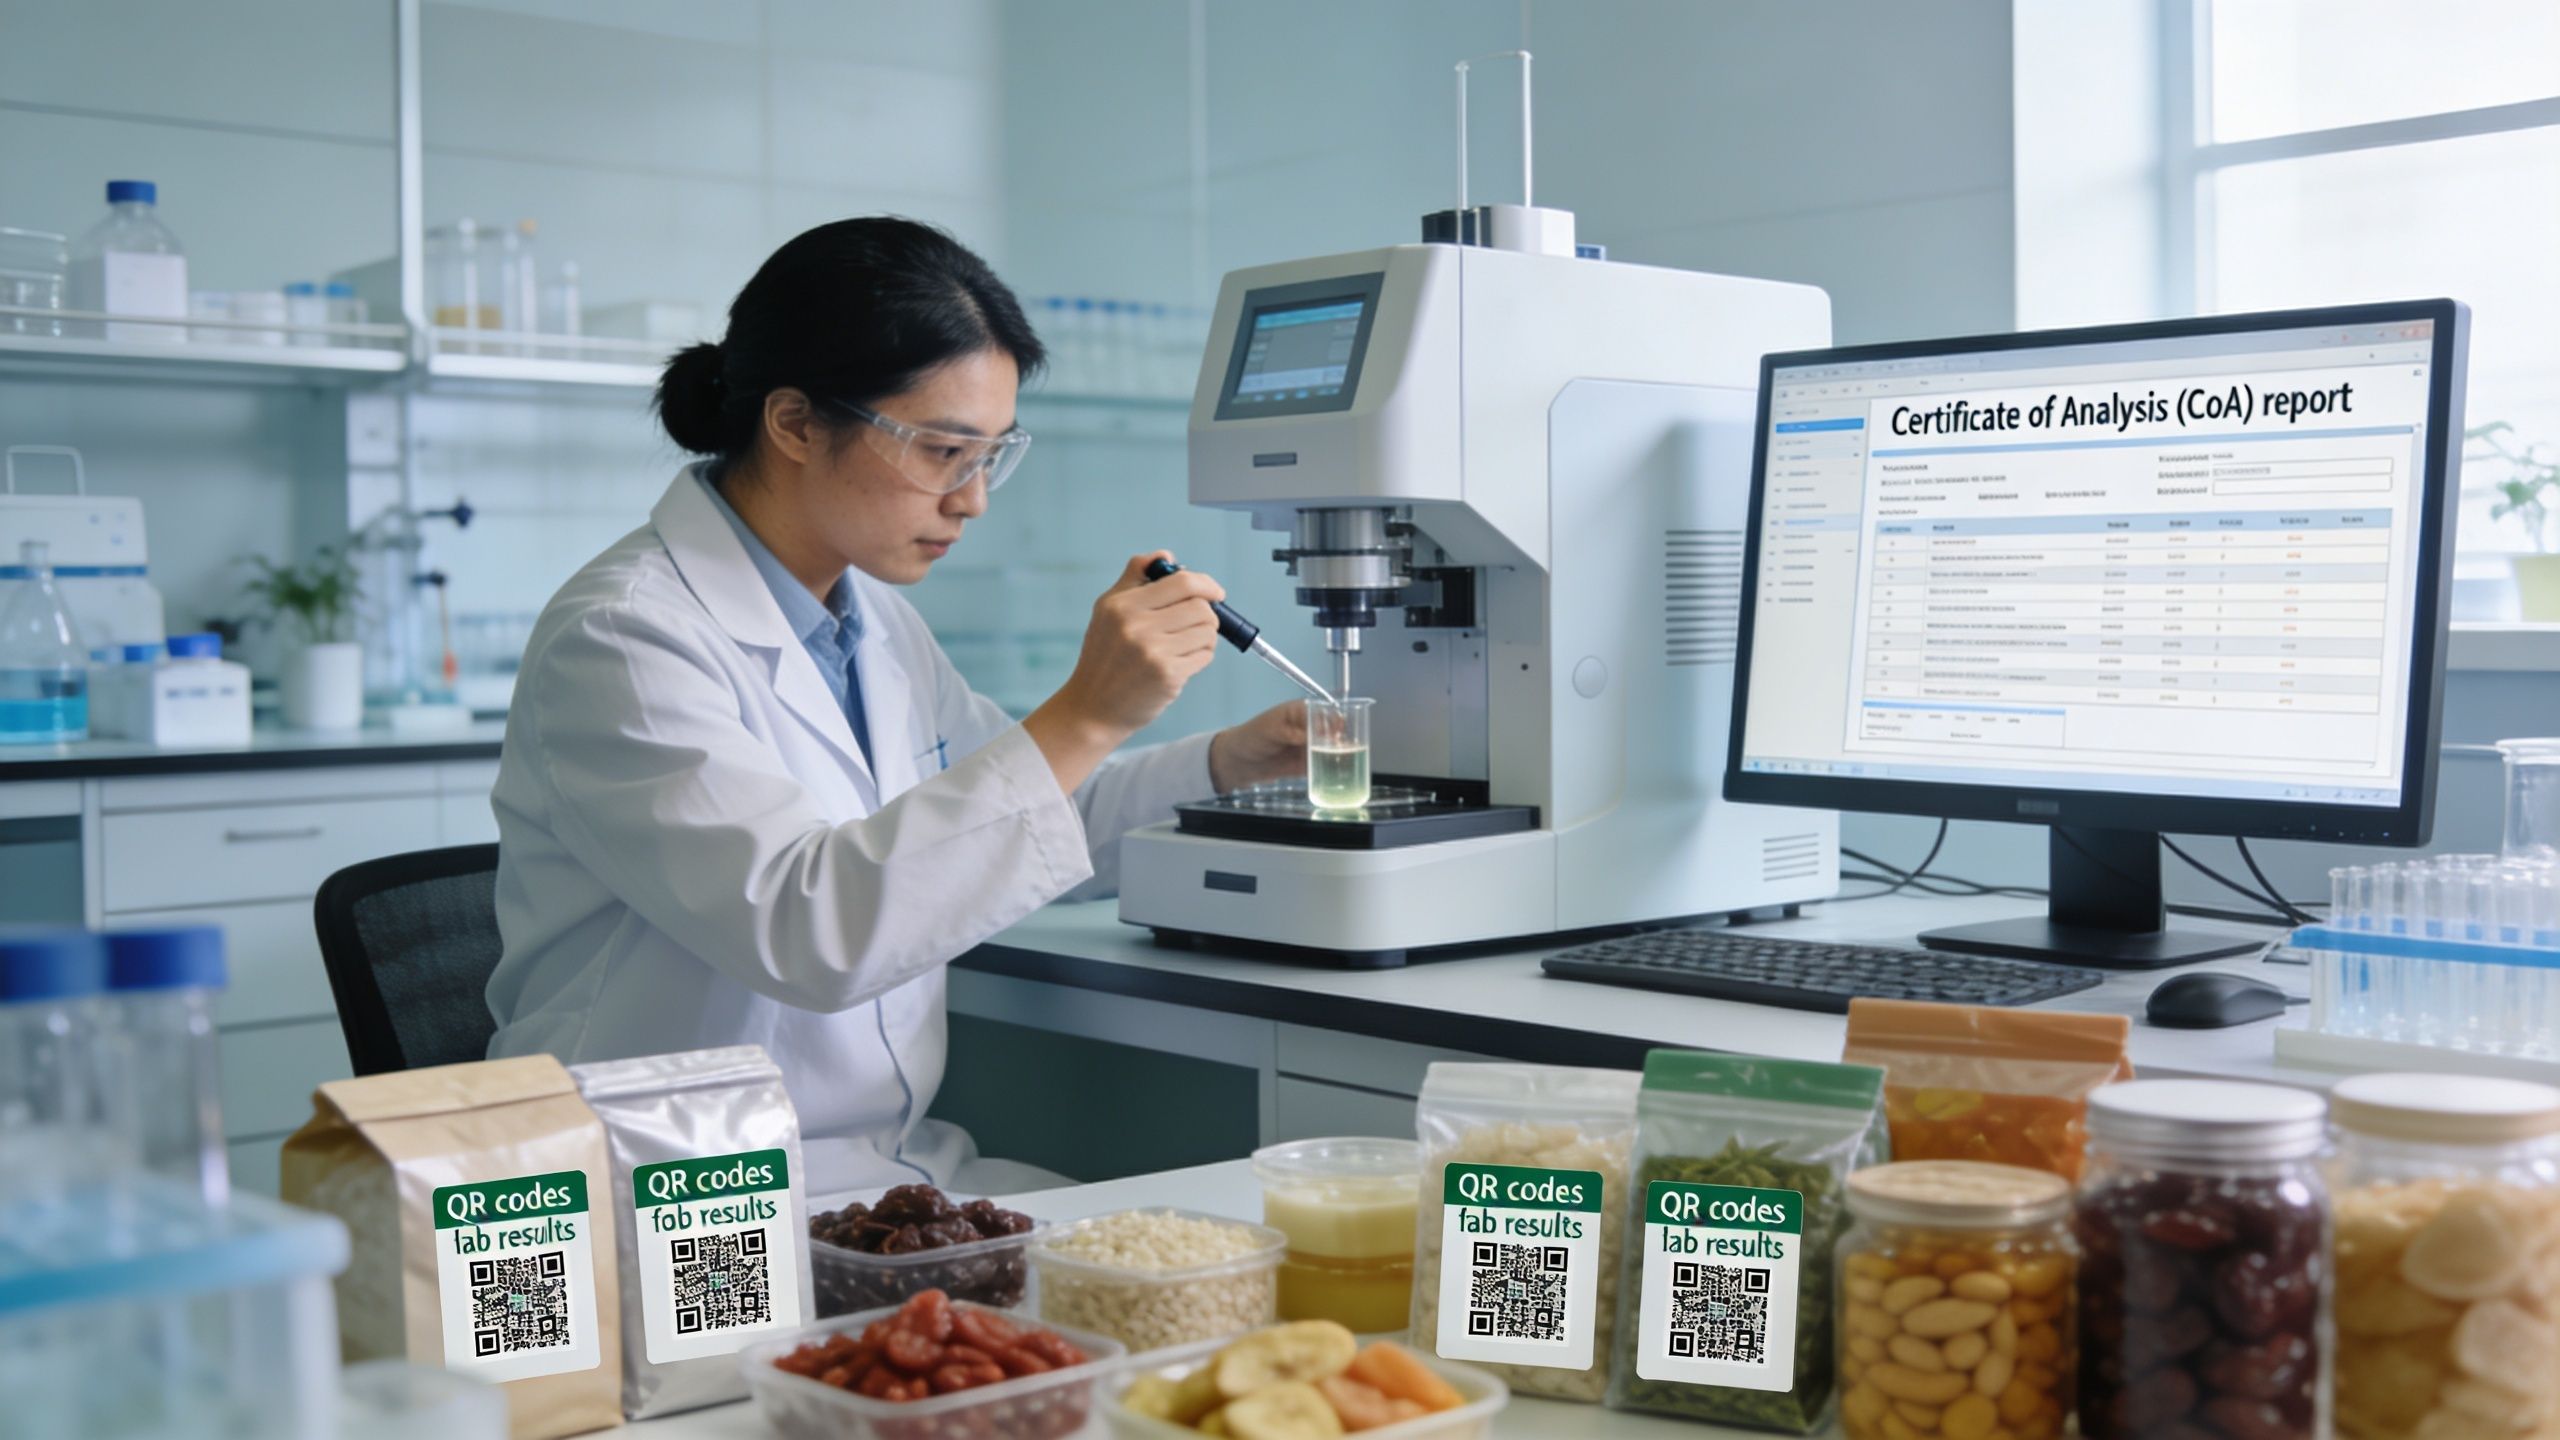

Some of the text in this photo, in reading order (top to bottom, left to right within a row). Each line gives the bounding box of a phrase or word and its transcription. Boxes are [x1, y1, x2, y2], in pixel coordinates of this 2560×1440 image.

[1892, 382, 2354, 436] Certificate of Analysis (CoA) report
[646, 1160, 774, 1200] QR codes
[1458, 1172, 1584, 1204] QR codes
[446, 1181, 572, 1224] QR codes
[699, 1195, 777, 1227] results
[1660, 1191, 1786, 1224] QR codes
[499, 1217, 576, 1250] results
[1505, 1212, 1583, 1239] results
[1662, 1226, 1784, 1260] lab results
